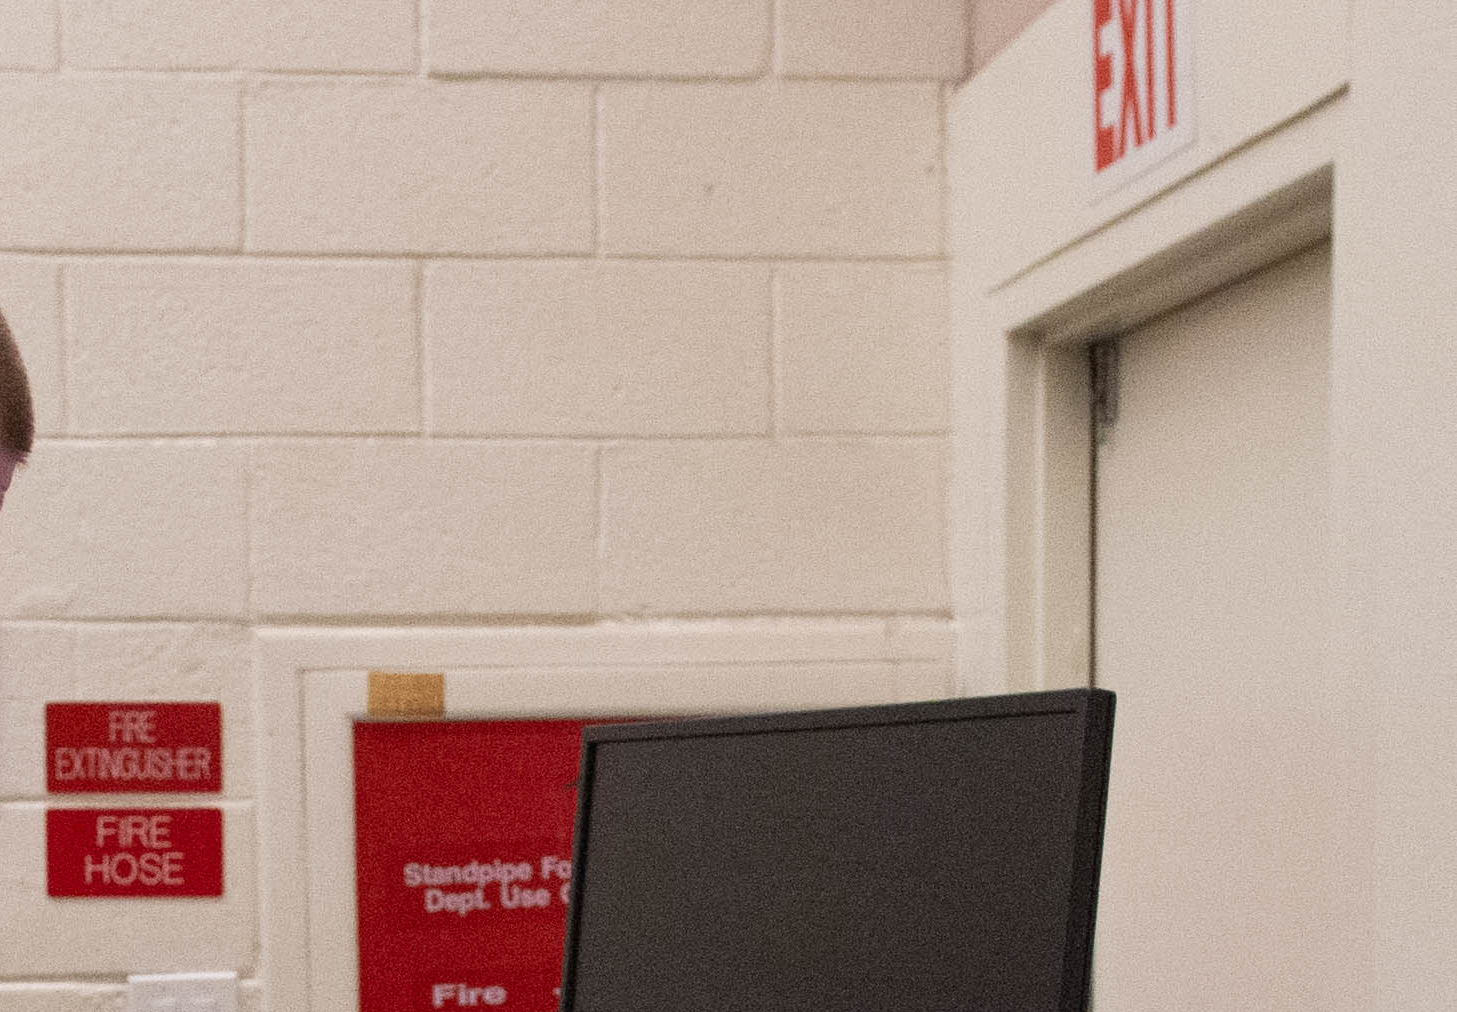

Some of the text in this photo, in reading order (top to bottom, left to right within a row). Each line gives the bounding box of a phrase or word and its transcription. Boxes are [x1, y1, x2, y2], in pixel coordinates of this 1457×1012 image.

[108, 709, 158, 744] FIRE
[54, 746, 211, 781] EXTINGUISHER
[95, 815, 172, 849] FIRE
[83, 851, 185, 886] HOSE
[403, 859, 532, 888] Standpipe
[501, 883, 550, 909] Use
[432, 983, 507, 1008] Fire
